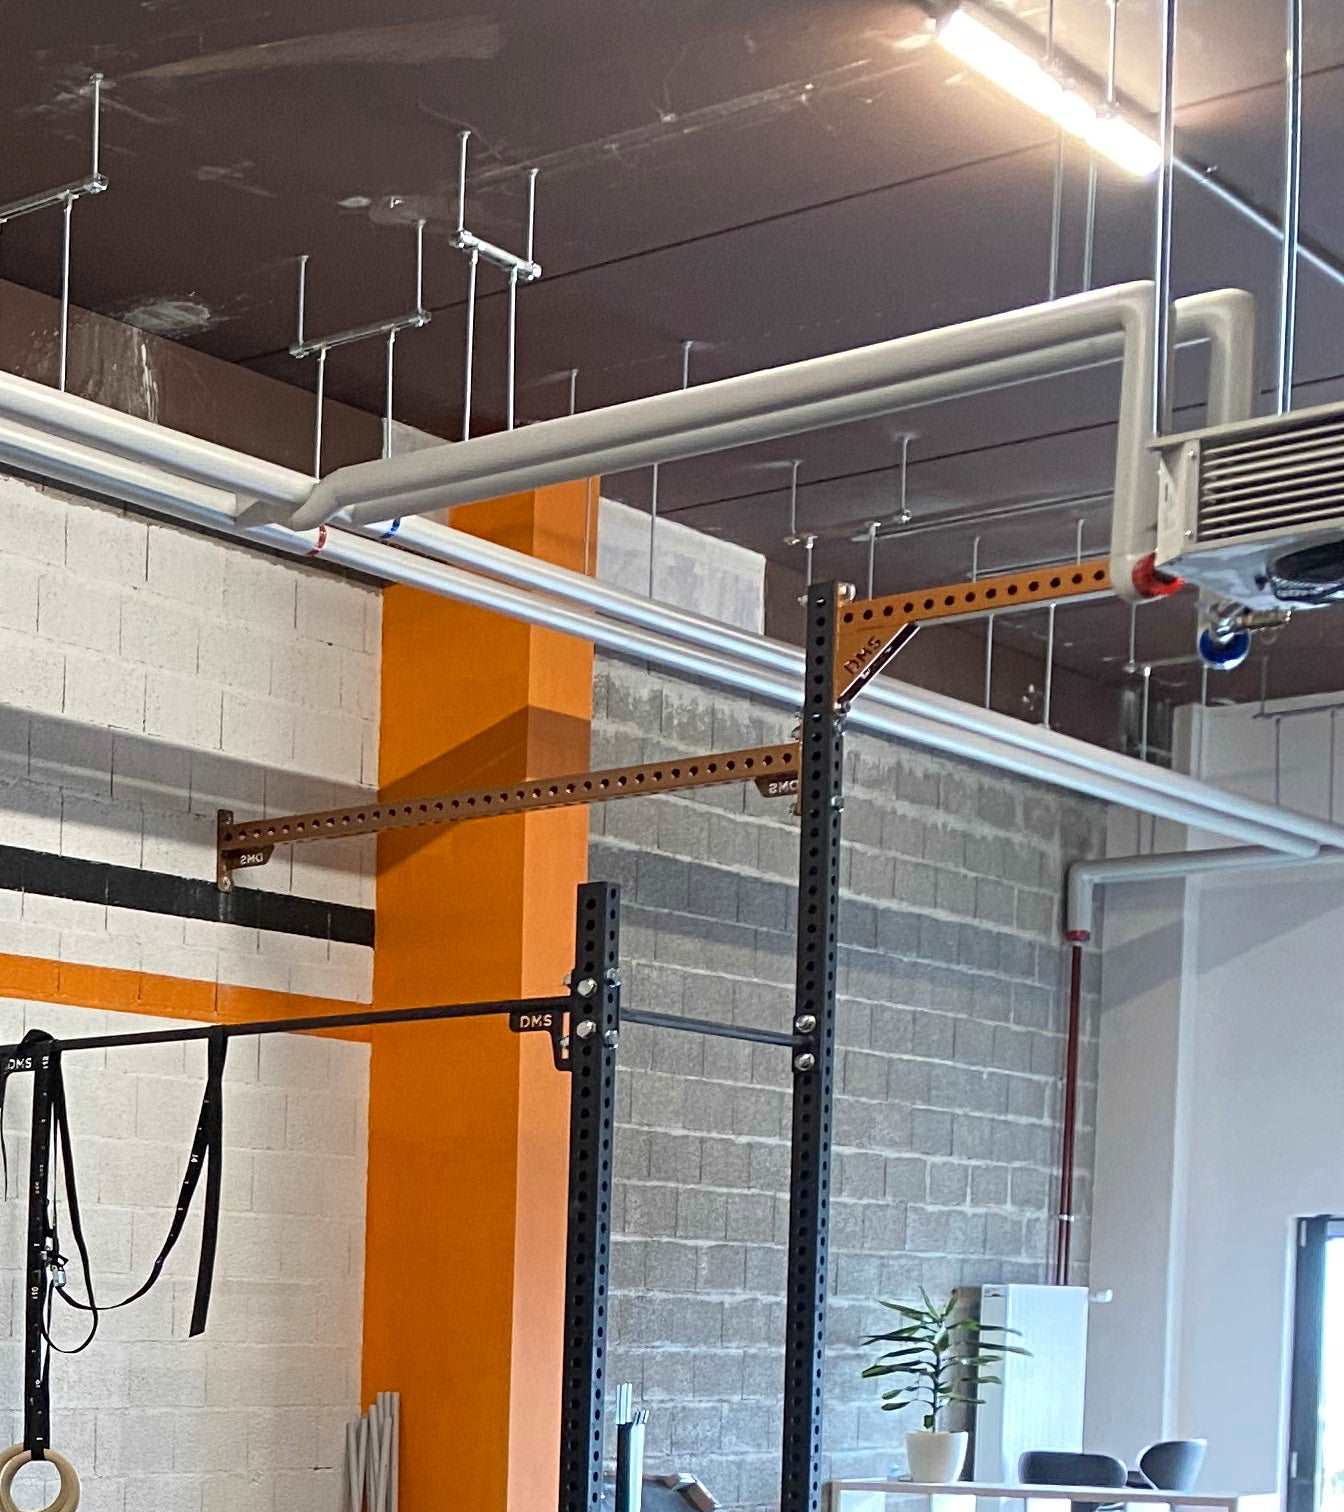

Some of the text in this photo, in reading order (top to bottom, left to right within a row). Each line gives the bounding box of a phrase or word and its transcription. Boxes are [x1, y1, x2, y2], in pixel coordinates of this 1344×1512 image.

[844, 636, 881, 674] DMS
[520, 1014, 552, 1028] DMS
[7, 1057, 32, 1070] DMS
